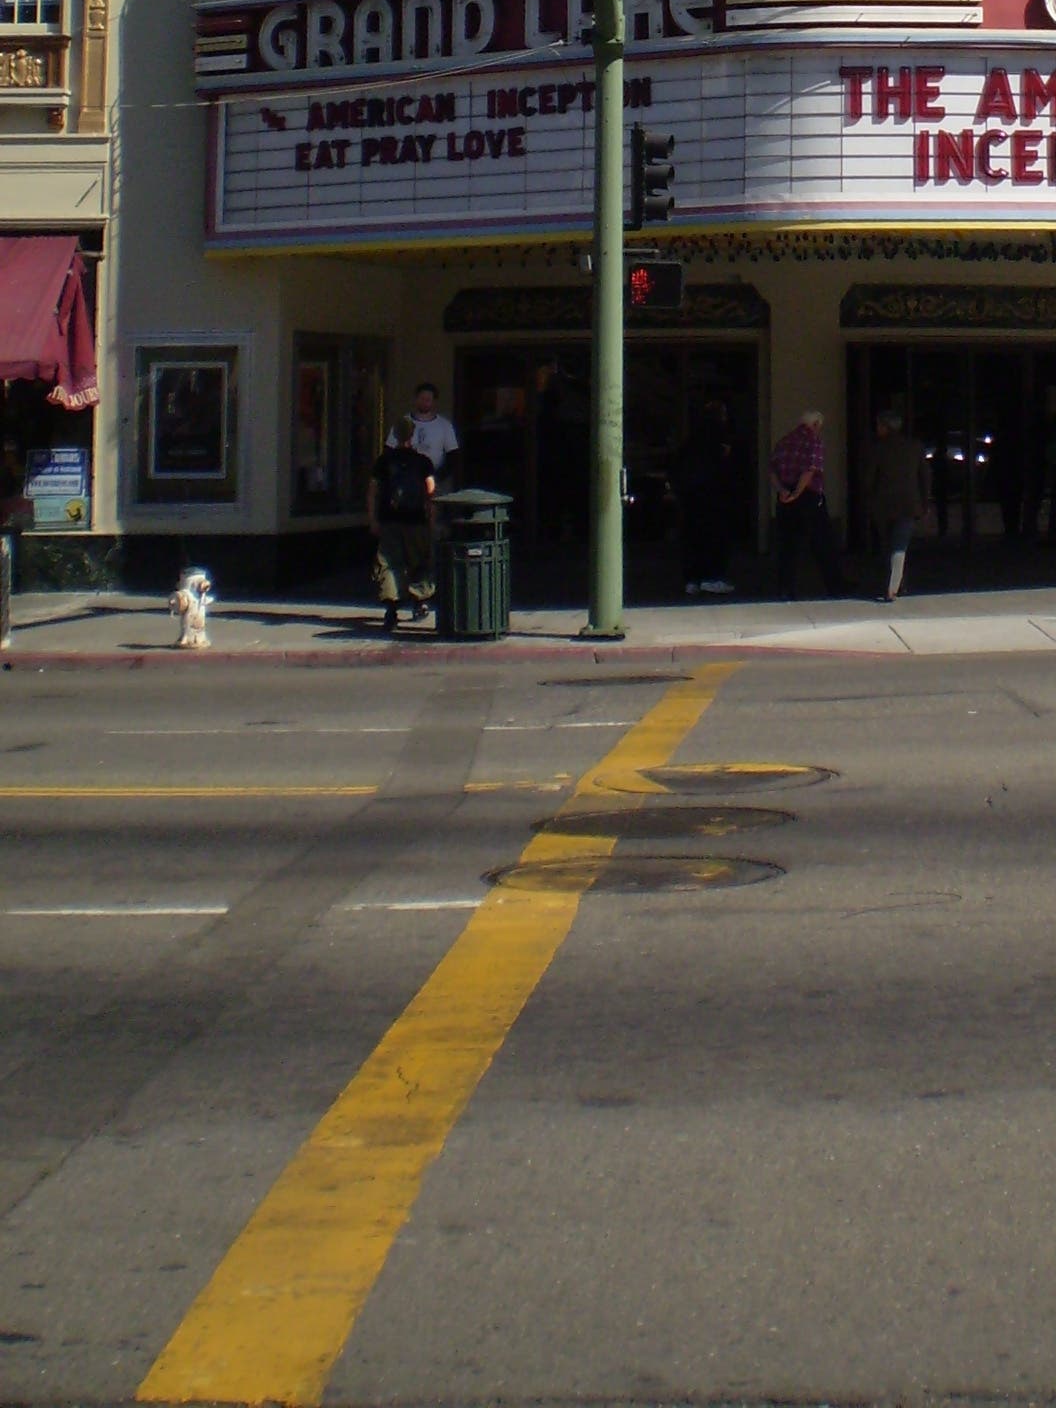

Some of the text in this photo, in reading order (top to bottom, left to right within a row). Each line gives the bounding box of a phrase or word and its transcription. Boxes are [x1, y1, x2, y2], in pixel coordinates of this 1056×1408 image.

[306, 93, 456, 132] AMERICAN
[486, 76, 652, 119] INCEPTN
[839, 65, 947, 122] THE
[295, 126, 527, 171] EAT PRAY LOVE
